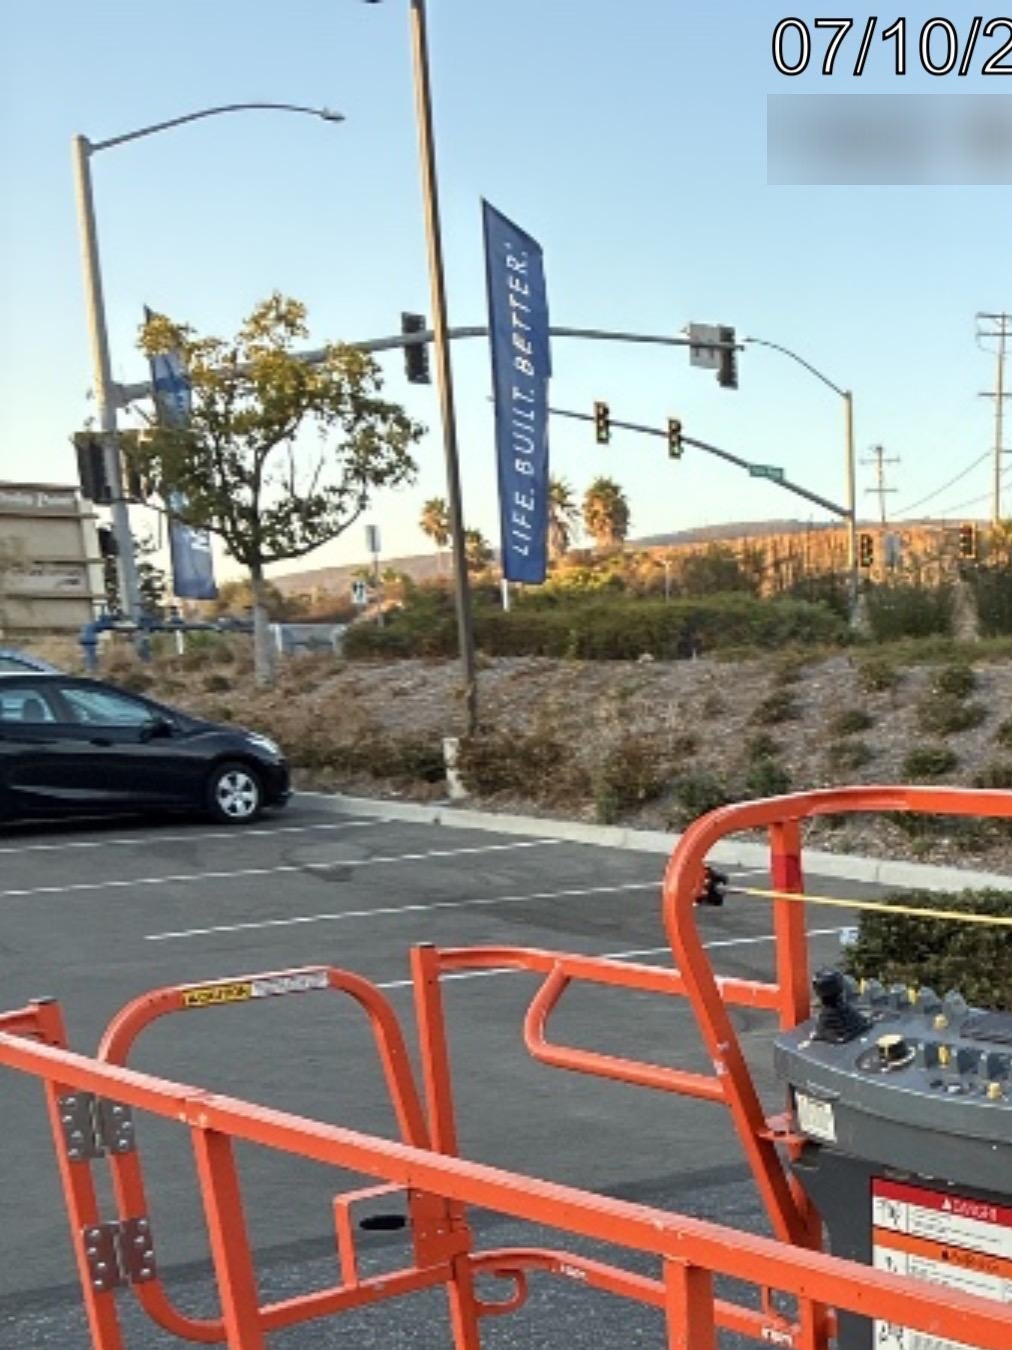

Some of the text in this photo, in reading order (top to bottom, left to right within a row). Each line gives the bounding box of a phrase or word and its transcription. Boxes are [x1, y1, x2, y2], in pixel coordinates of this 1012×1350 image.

[506, 250, 535, 557] LIFE. BUILT. BETTER.
